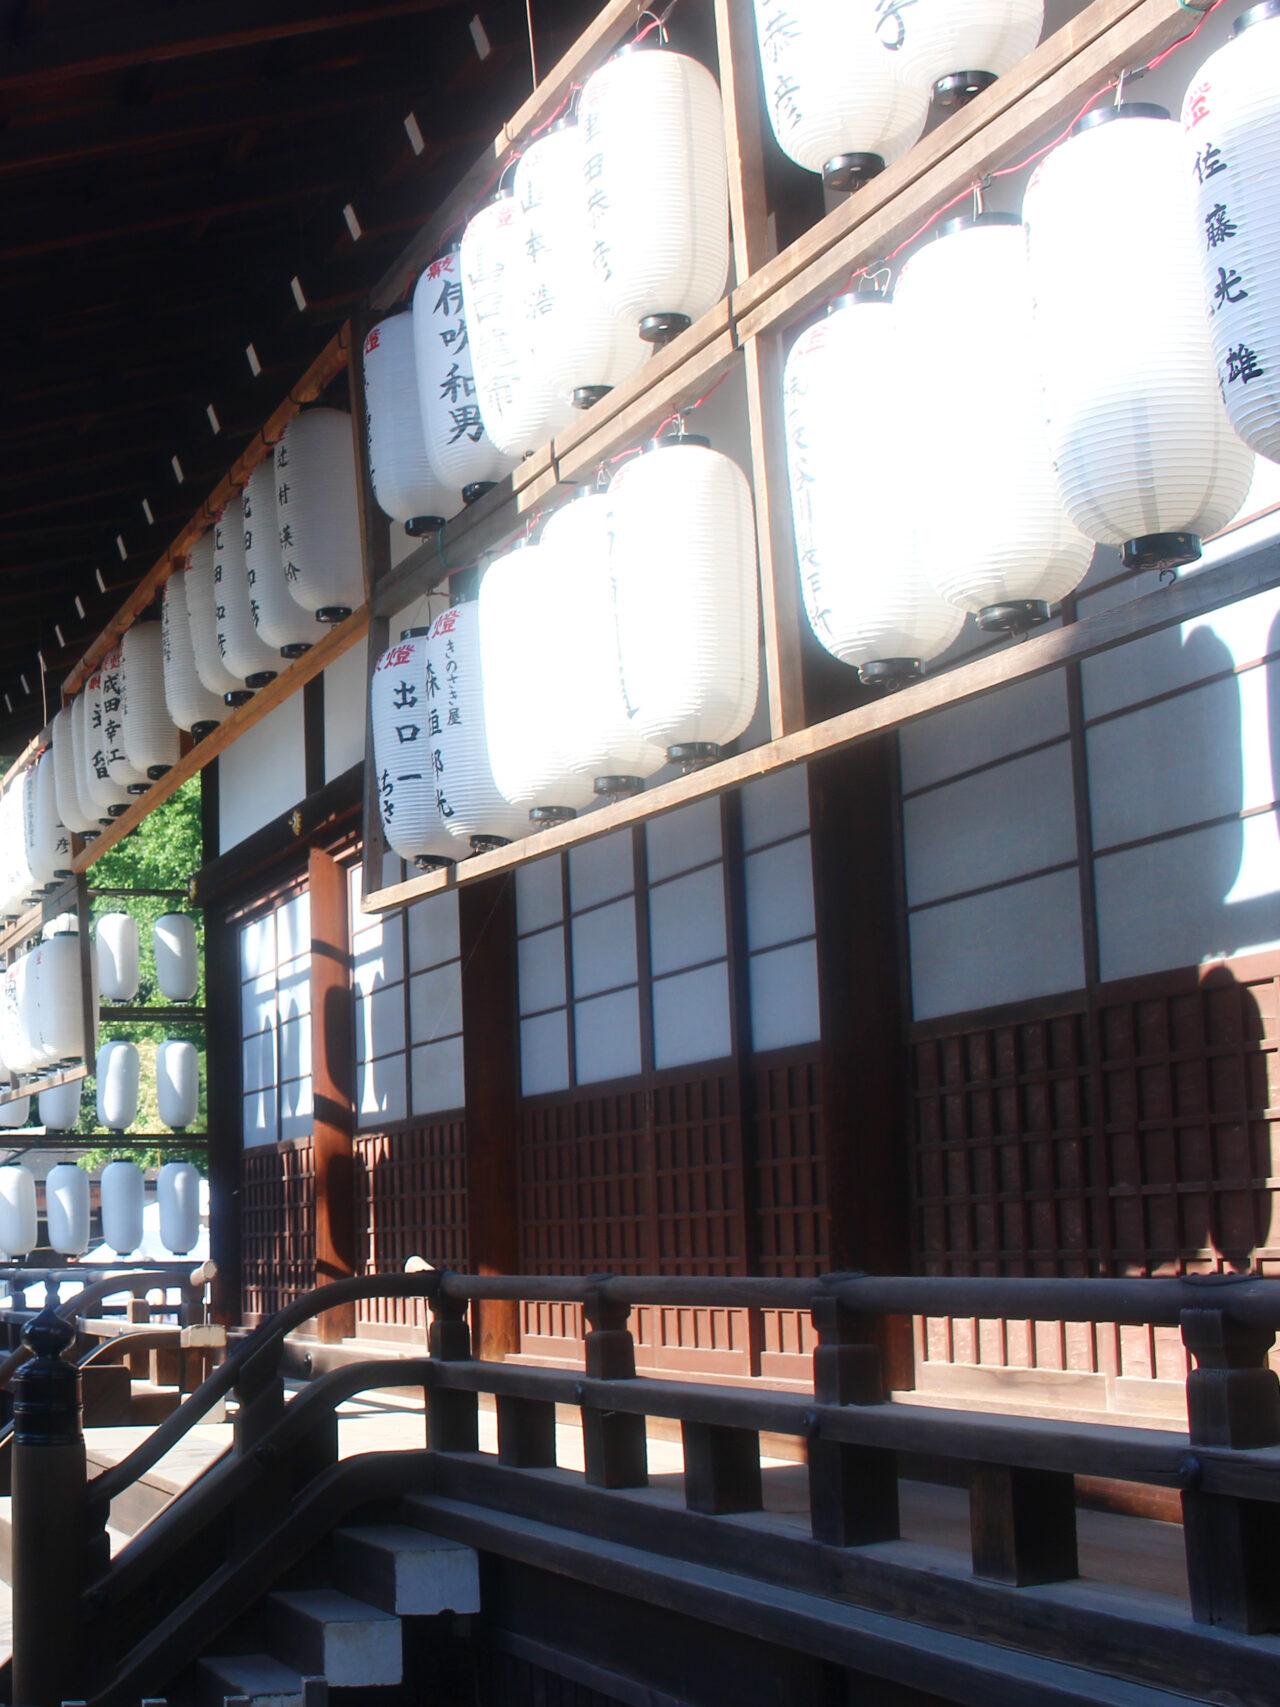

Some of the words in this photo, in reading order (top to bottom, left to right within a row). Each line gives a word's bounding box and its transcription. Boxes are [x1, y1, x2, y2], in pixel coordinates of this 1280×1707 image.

[1192, 141, 1264, 385] 佐藤光雄
[433, 280, 484, 445] 伊吹和男
[103, 673, 126, 765] 成田幸江
[393, 680, 423, 781] 出口一
[446, 639, 462, 727] きのさき屋
